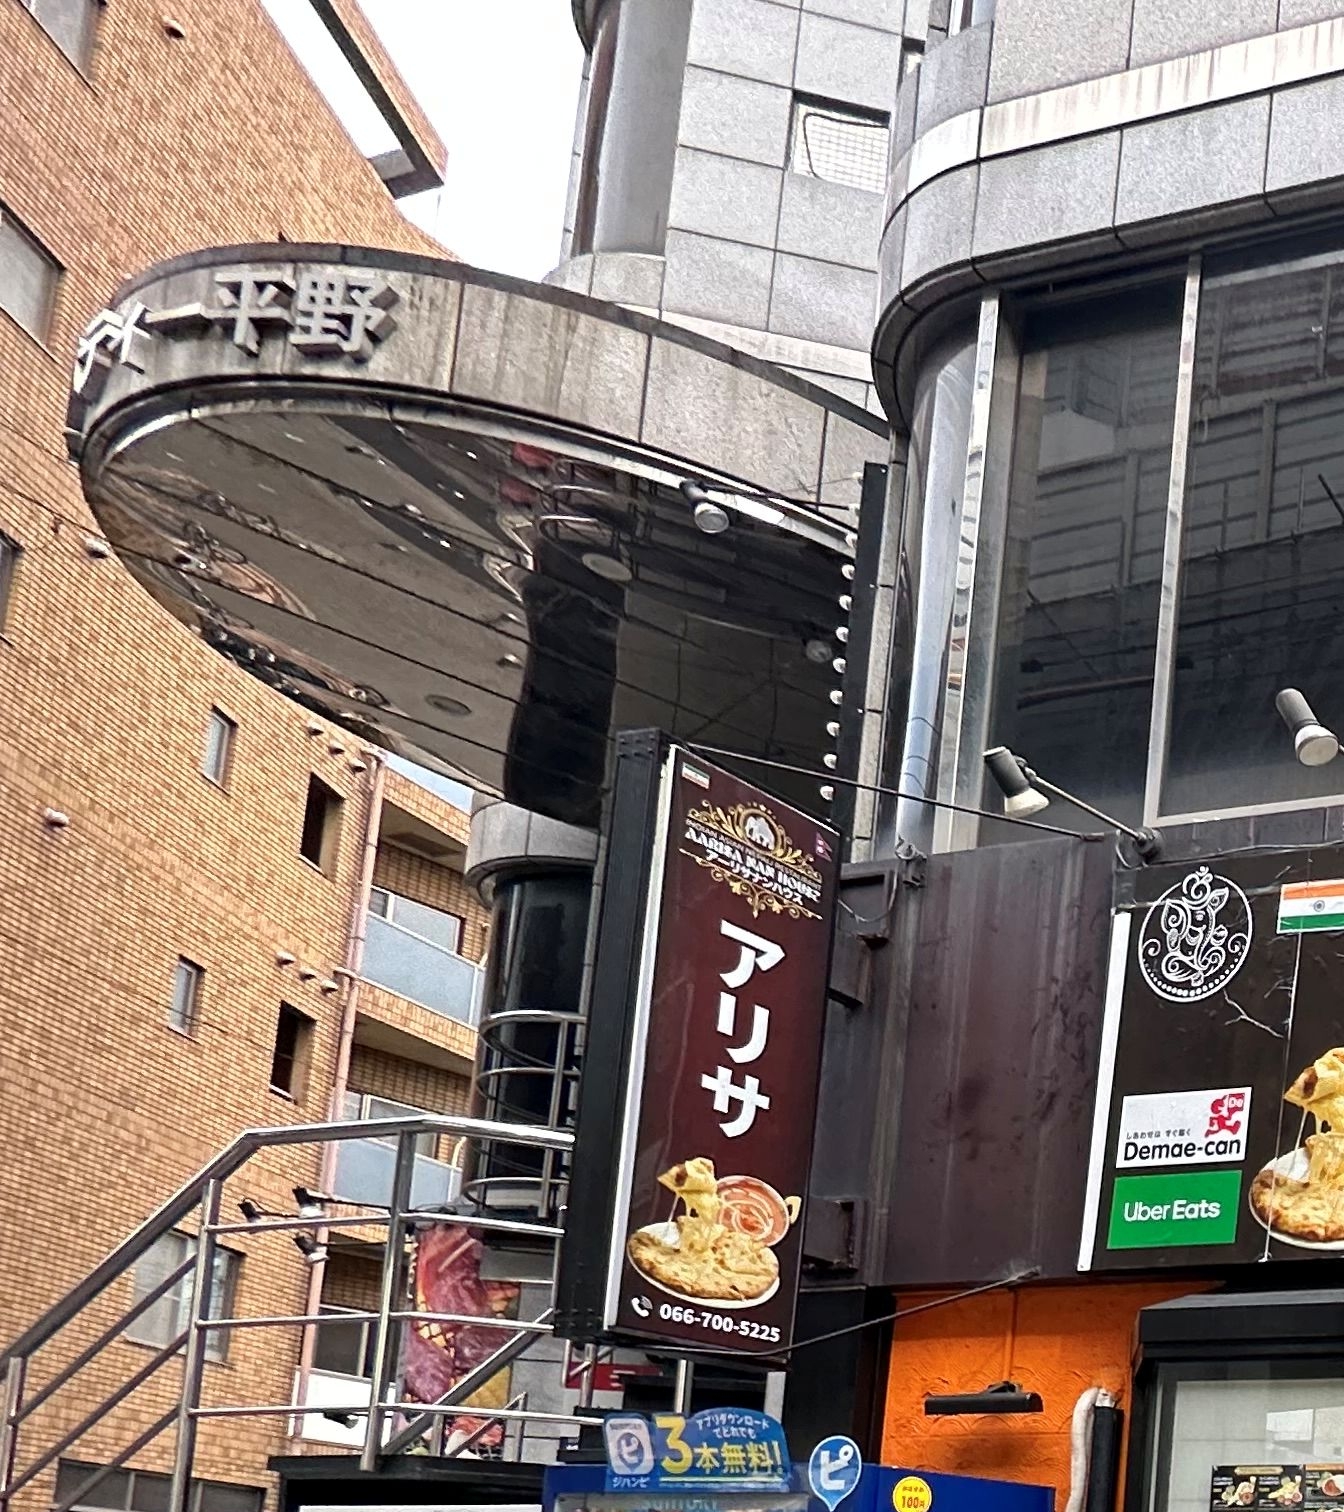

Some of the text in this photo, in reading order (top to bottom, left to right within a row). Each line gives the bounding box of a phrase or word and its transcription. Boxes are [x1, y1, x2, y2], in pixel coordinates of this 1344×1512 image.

[701, 919, 786, 1139] アリサ
[1124, 1138, 1241, 1161] Demae-can
[1124, 1199, 1221, 1222] Uber Eats
[659, 1302, 781, 1342] 066-700-5225
[820, 1444, 854, 1490] ピ
